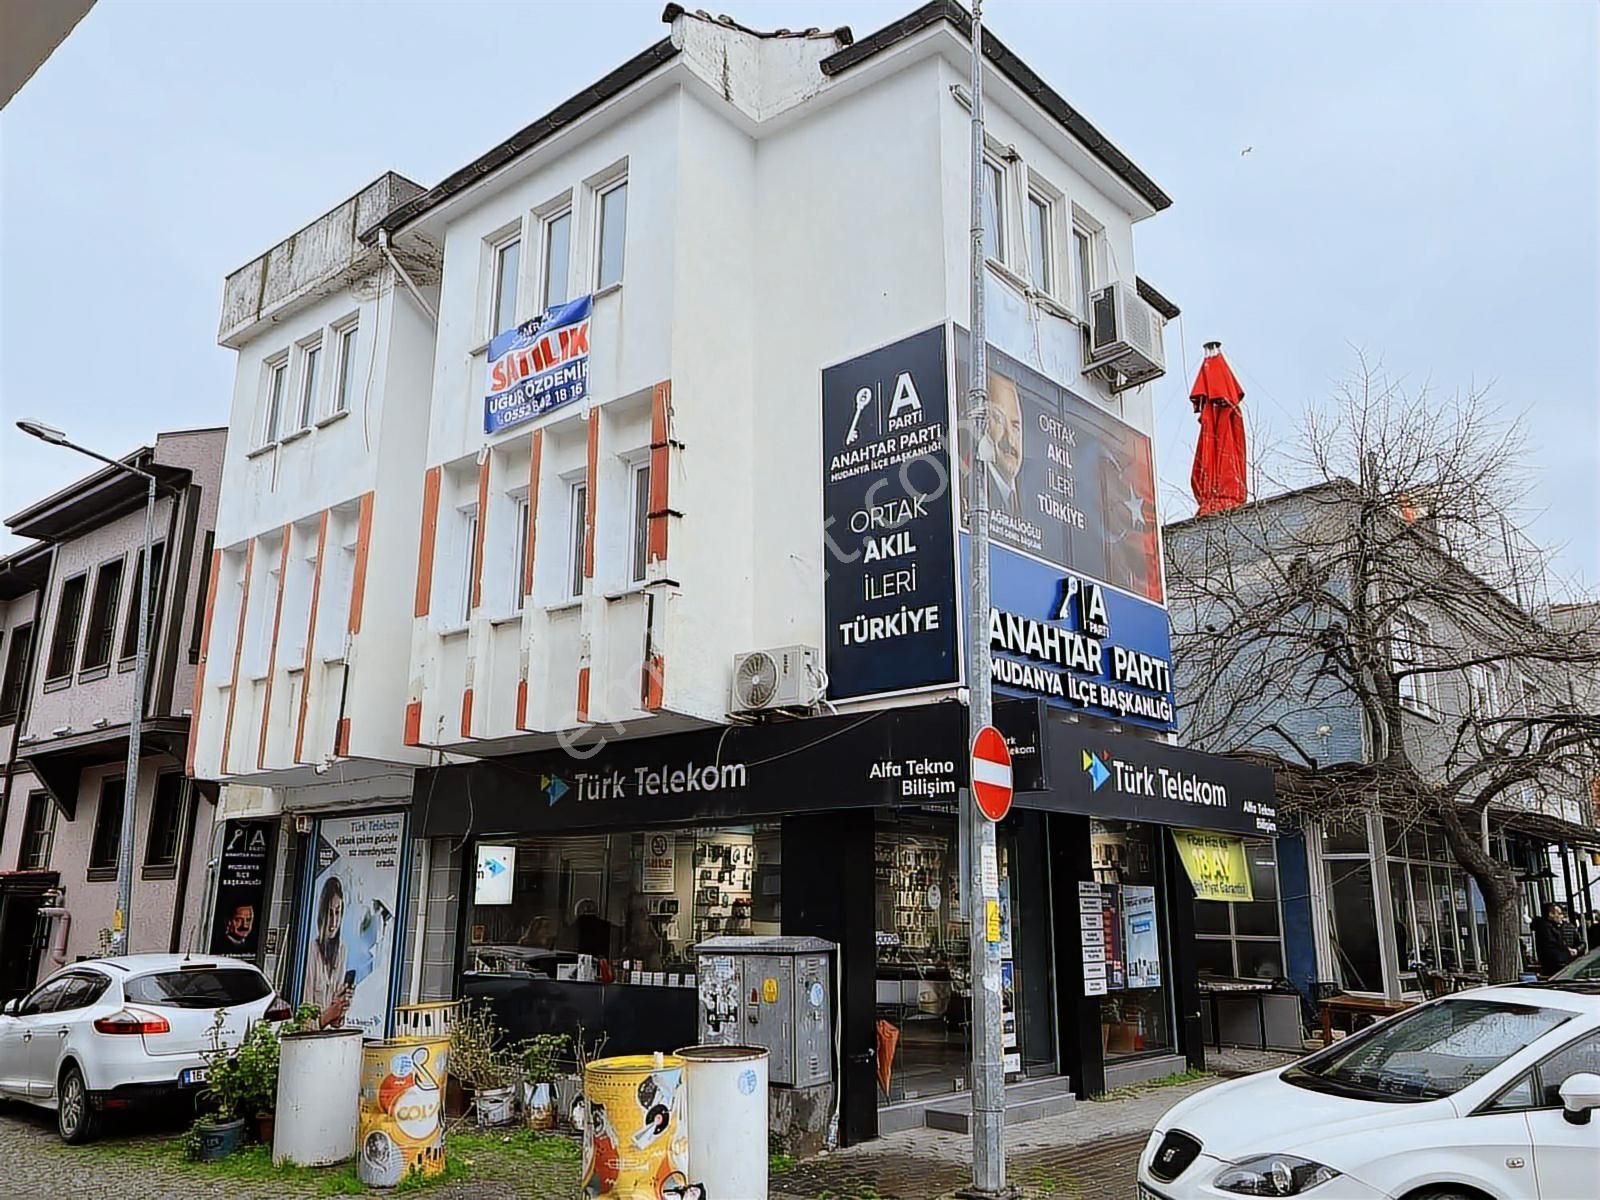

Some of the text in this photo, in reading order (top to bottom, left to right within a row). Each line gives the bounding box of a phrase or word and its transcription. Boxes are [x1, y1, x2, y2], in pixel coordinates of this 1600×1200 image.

[491, 322, 589, 391] SATILIK
[489, 390, 525, 413] UĞUR
[555, 387, 567, 403] 18
[571, 383, 583, 397] 16
[889, 372, 922, 418] A
[888, 410, 922, 432] PARTİ
[1038, 415, 1077, 447] ORTAK
[831, 424, 942, 471] ANAHTAR PARTİ
[1047, 443, 1073, 470] AKIL
[1048, 467, 1075, 498] İLERİ
[850, 494, 929, 533] ORTAK
[1037, 493, 1086, 530] TÜRKİYE
[864, 531, 917, 564] AKIL
[864, 563, 917, 601] İLERİ
[1089, 584, 1108, 622] A
[839, 605, 940, 646] TÜRKİYE
[989, 607, 1171, 693] ANAHTAR PARTİ
[990, 658, 1174, 723] MUDANYA İLÇE BAŞKANLIĞI
[575, 761, 746, 801] Türk Telekom
[869, 758, 954, 779] Alfa Tekno
[1113, 760, 1228, 807] Türk Telekom
[902, 778, 955, 798] Bilişim
